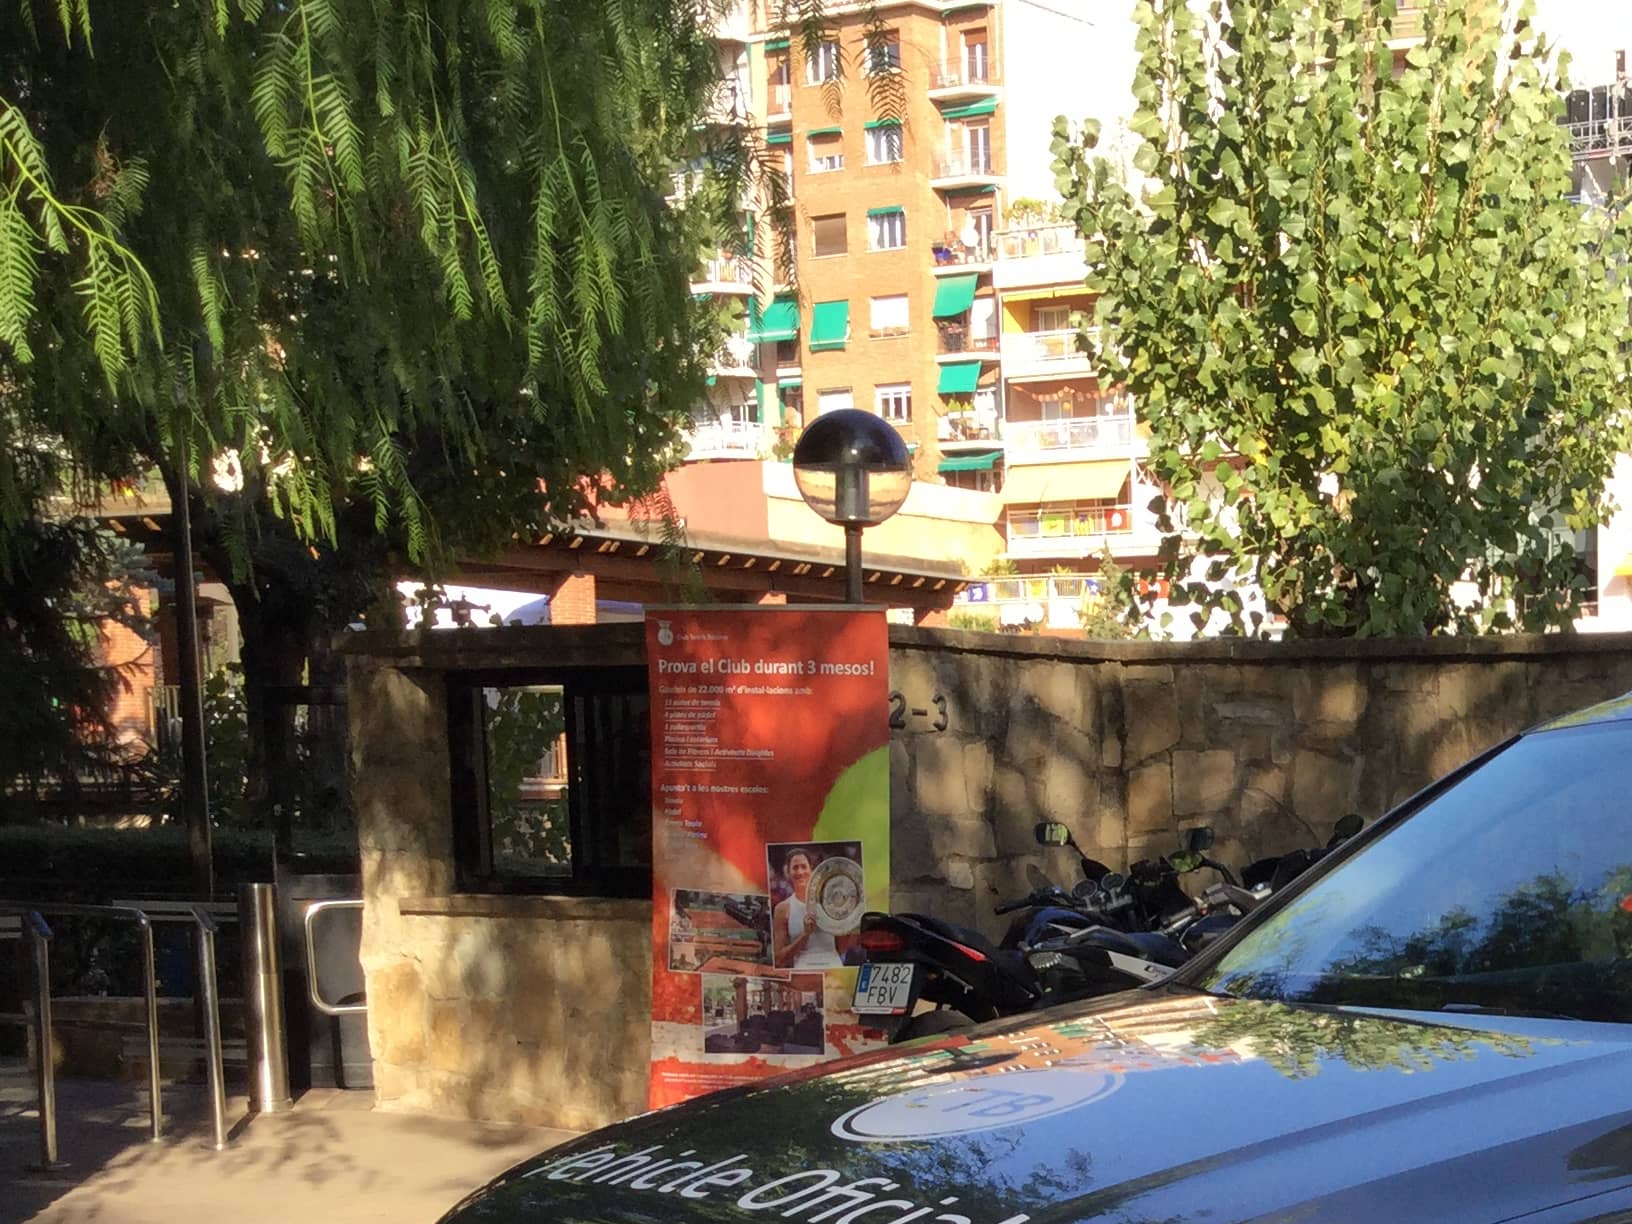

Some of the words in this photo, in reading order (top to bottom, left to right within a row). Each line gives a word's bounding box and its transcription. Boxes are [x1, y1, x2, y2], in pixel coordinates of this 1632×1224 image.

[659, 659, 697, 673] Prova
[701, 658, 714, 674] el
[718, 659, 751, 674] Club
[754, 659, 804, 675] durant
[807, 660, 817, 675] 3
[821, 660, 875, 676] mesos!
[872, 966, 911, 985] 7482
[867, 986, 898, 1004] FBV
